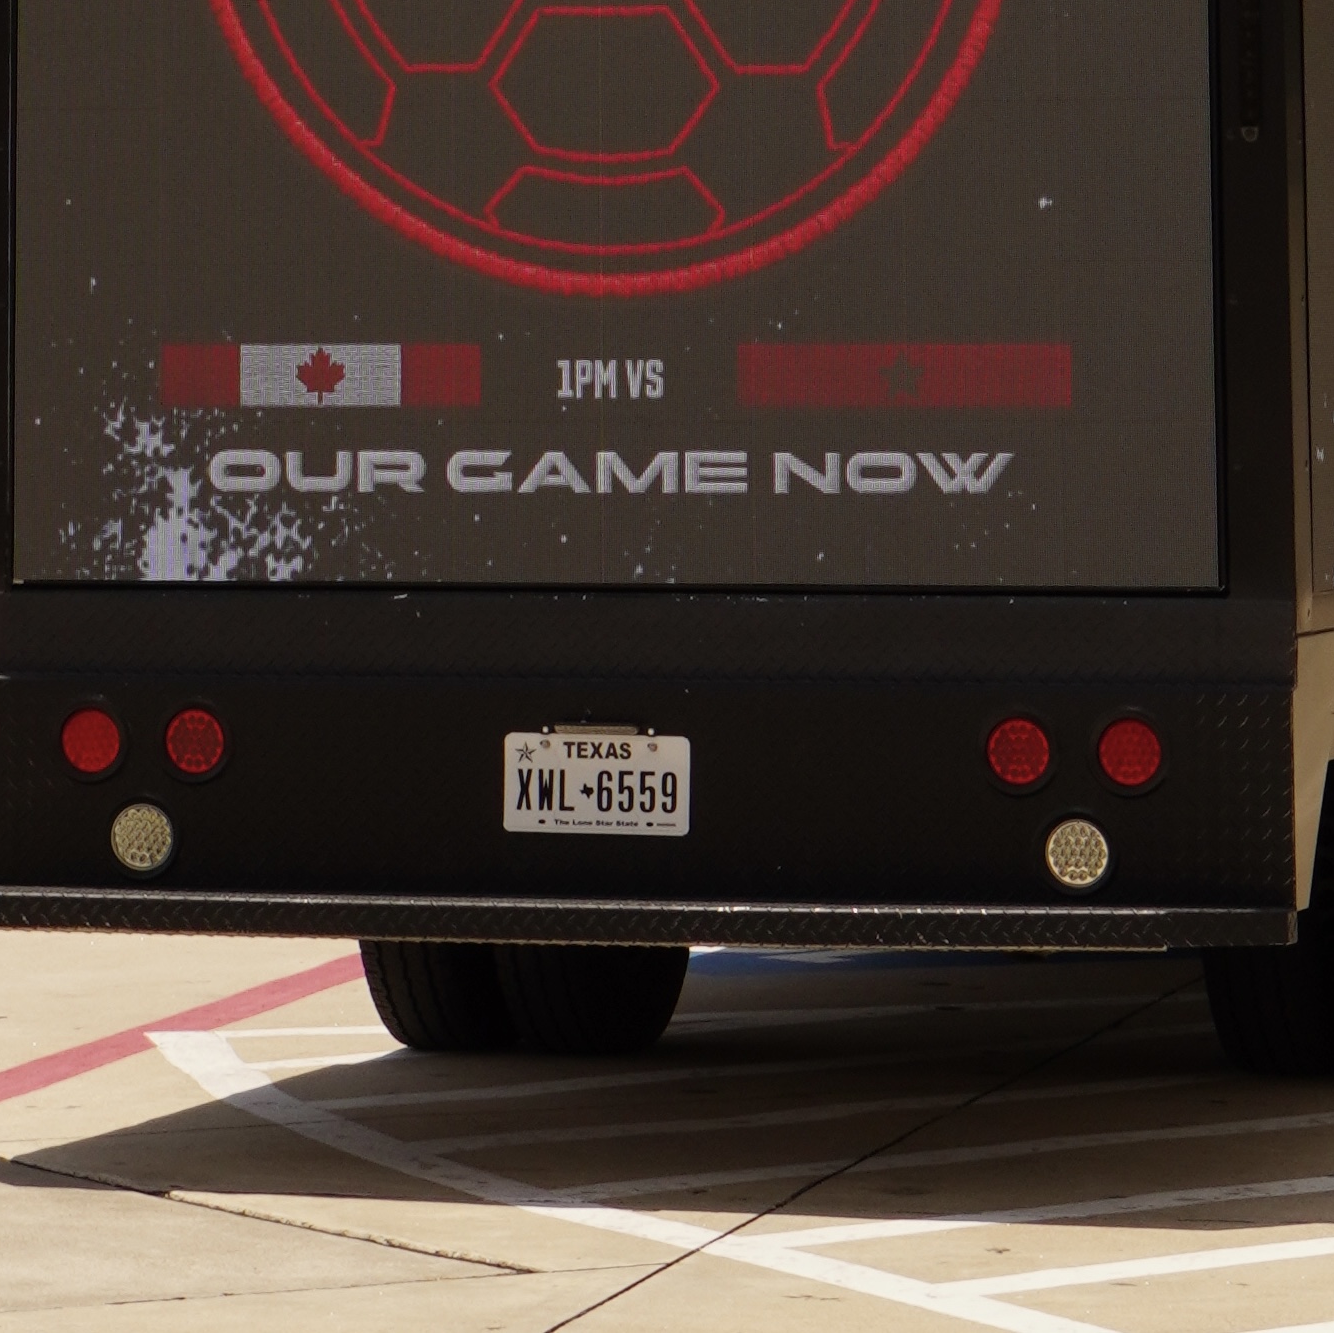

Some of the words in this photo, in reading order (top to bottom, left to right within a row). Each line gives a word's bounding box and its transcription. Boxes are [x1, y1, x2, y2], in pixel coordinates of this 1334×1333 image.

[556, 358, 617, 398] 1PM
[626, 359, 665, 398] VS
[209, 449, 427, 495] OUR
[445, 449, 749, 495] GAME
[772, 451, 1015, 495] NOW
[563, 741, 632, 760] TEXAS
